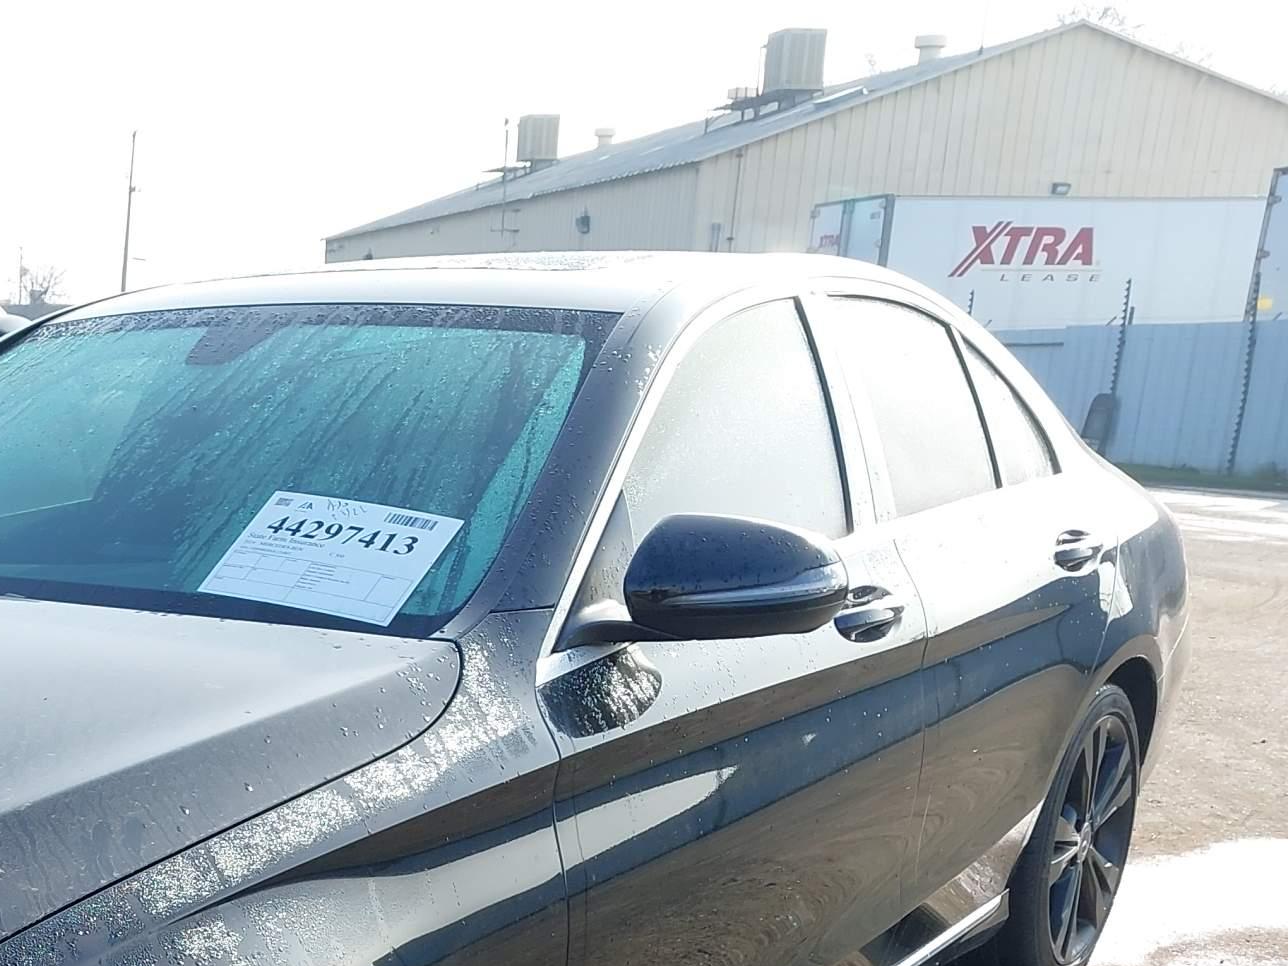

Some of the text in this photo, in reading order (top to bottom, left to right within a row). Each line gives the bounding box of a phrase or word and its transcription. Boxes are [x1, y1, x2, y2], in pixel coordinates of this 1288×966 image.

[948, 221, 1094, 278] XTRA
[999, 273, 1101, 283] LEASE
[266, 515, 420, 556] 44297413
